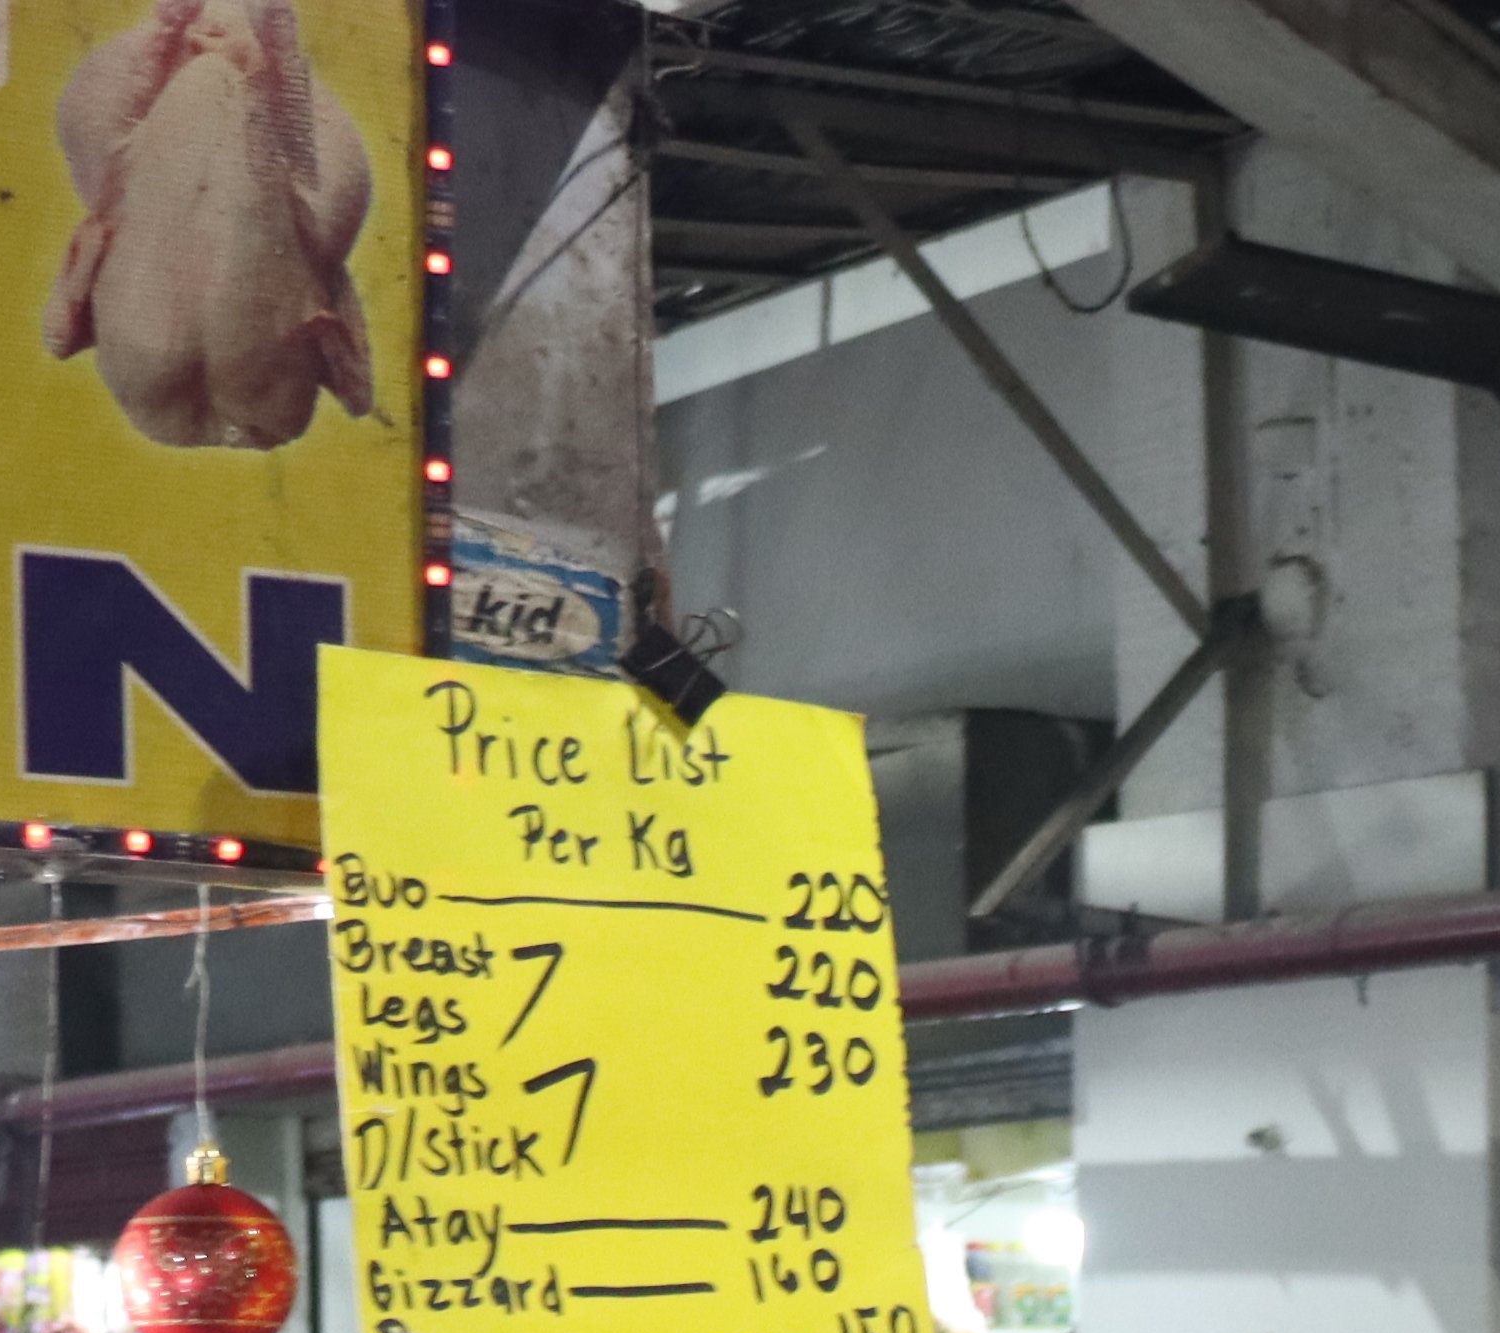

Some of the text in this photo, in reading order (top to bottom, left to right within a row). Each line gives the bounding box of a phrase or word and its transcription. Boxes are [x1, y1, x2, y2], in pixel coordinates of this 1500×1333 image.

[423, 680, 731, 786] Price List
[507, 803, 693, 878] Per Kg
[334, 852, 889, 934] Buo 220
[334, 918, 882, 1011] Breast 220
[361, 981, 467, 1045] Legs
[352, 1025, 877, 1116] Wings 230
[381, 1184, 845, 1279] Atay 240
[368, 1248, 840, 1316] Gizzard 160
